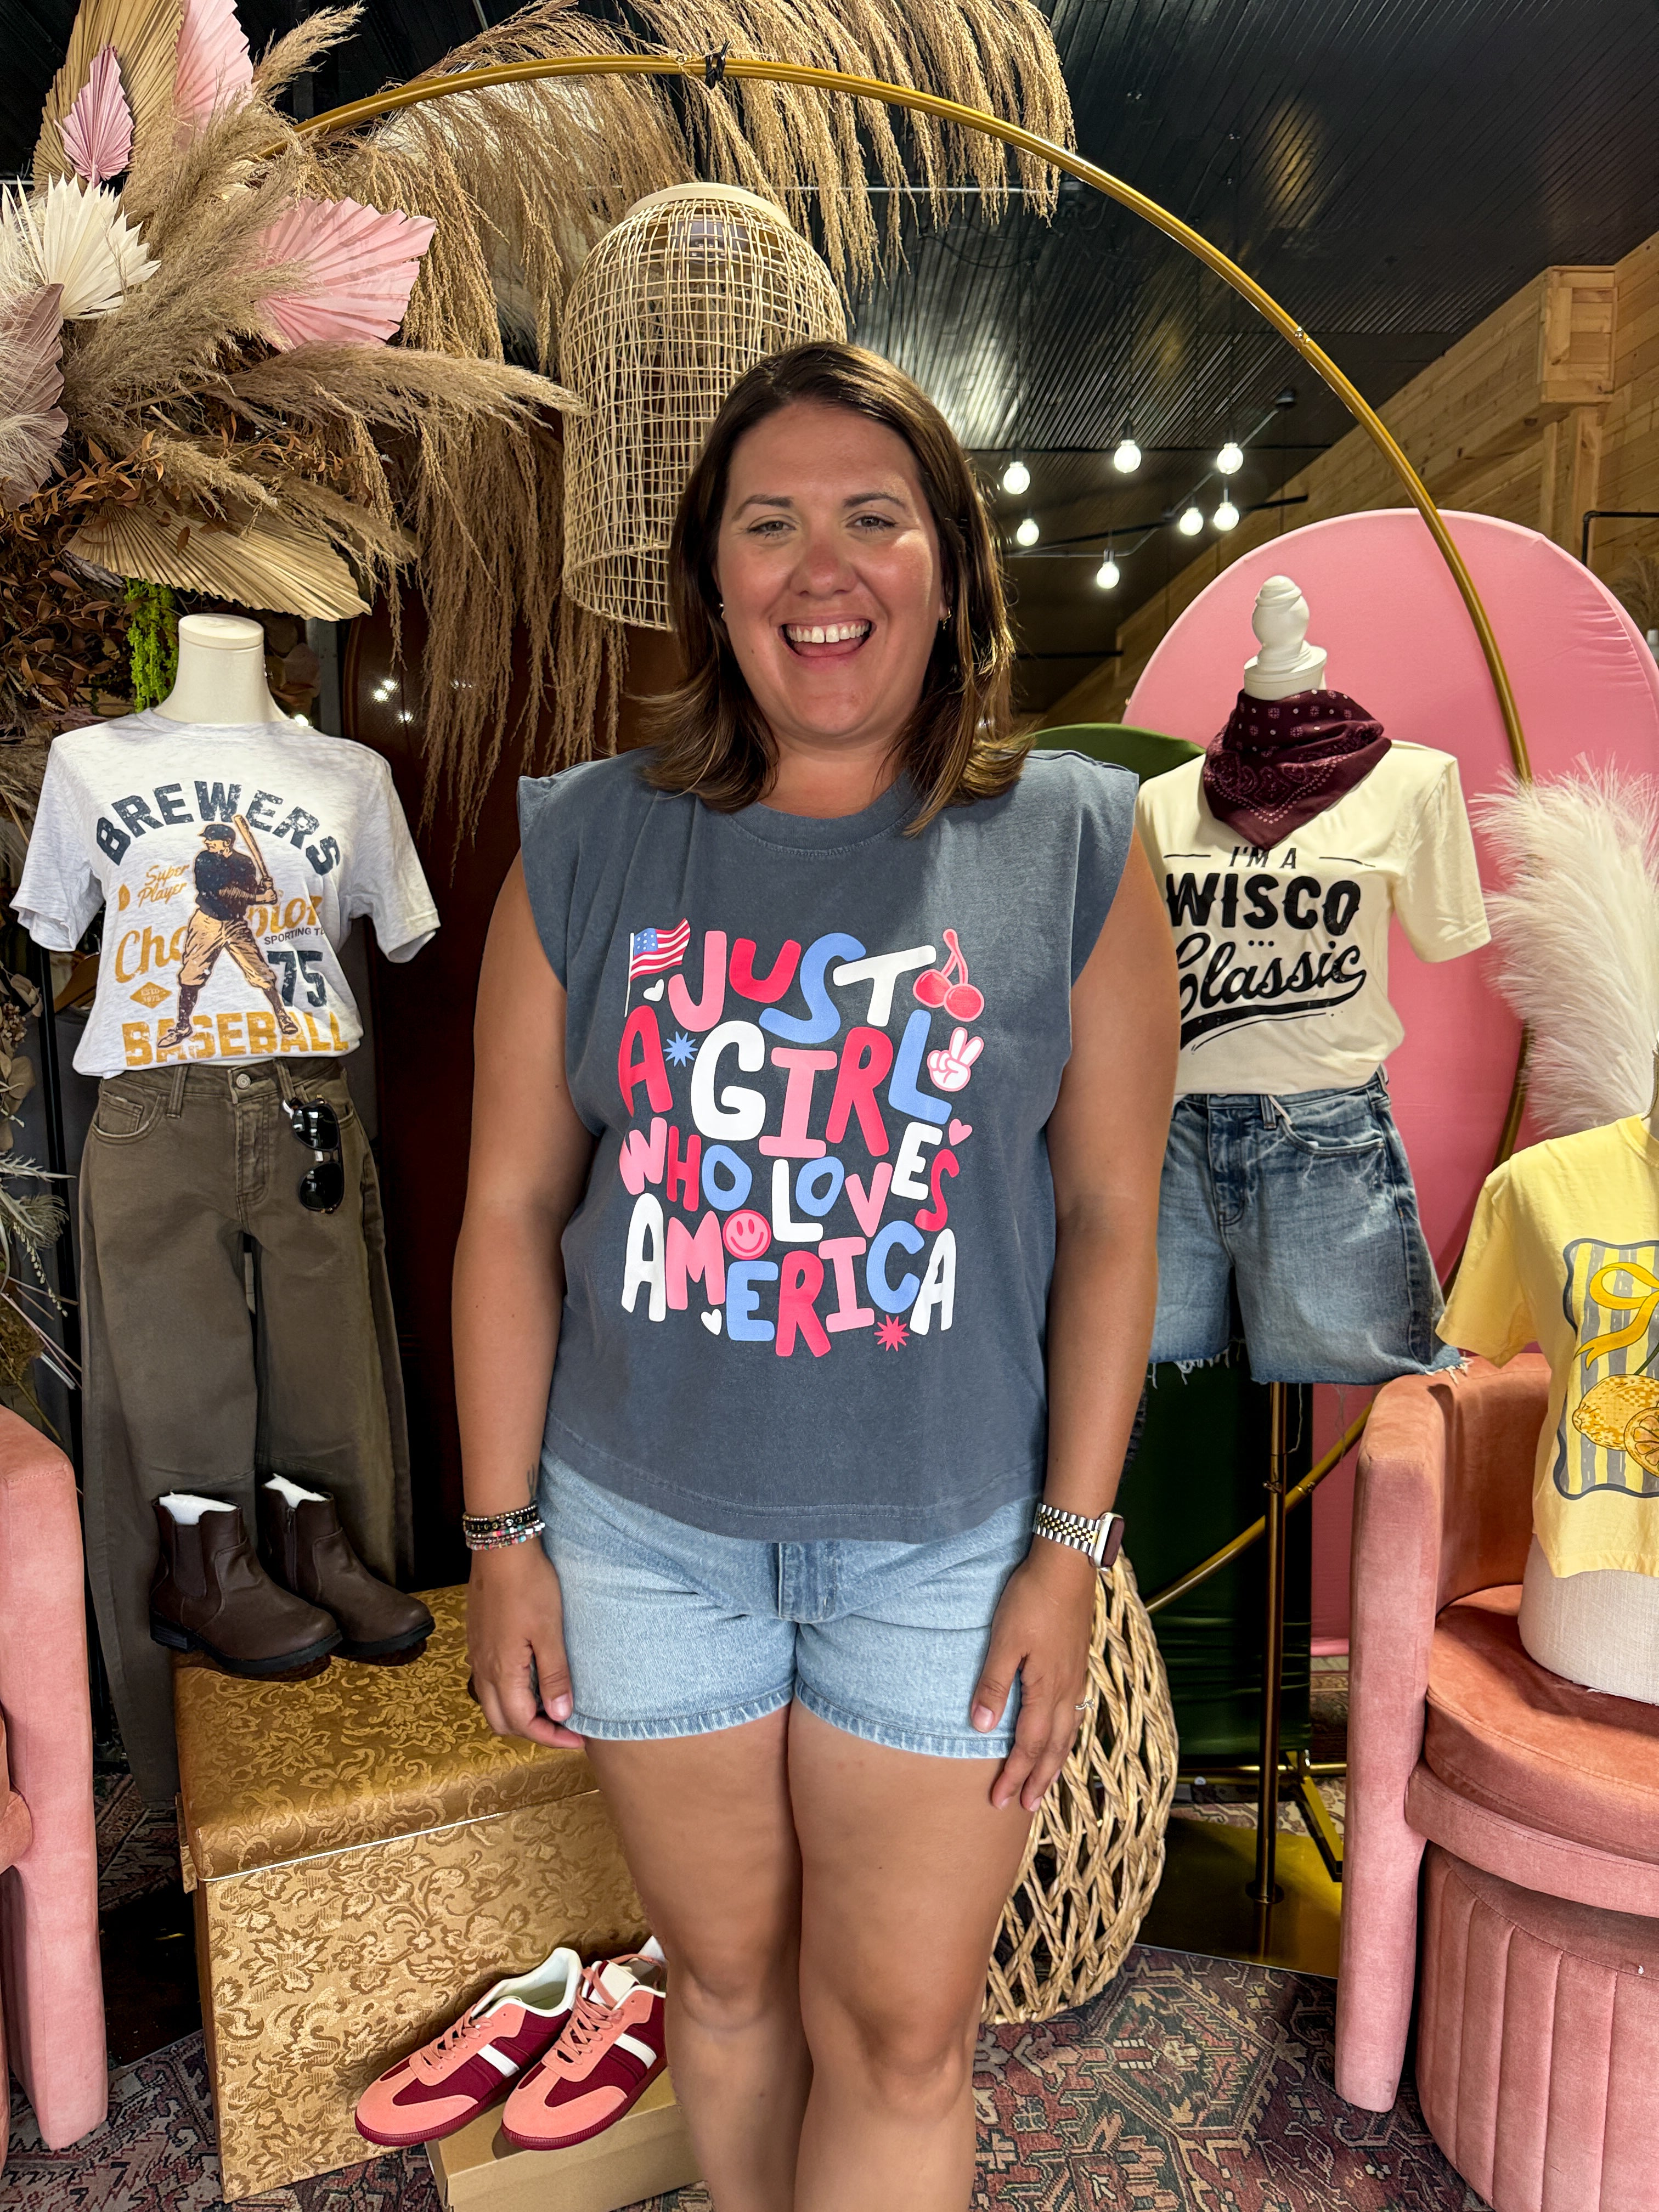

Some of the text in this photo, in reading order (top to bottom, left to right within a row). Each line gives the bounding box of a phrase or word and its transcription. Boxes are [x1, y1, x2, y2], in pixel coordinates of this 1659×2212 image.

[96, 781, 341, 876] BREWERS
[1228, 847, 1297, 869] I'M A
[137, 882, 188, 909] Player
[144, 865, 190, 887] Super
[1166, 873, 1361, 936] WISCO
[264, 927, 311, 946] SPORTING
[267, 950, 328, 1007] 75
[668, 930, 936, 1044] JUST
[618, 1005, 952, 1159] A GIRL
[619, 1117, 960, 1243] WHO LOVES
[621, 1193, 957, 1357] AMERICA
